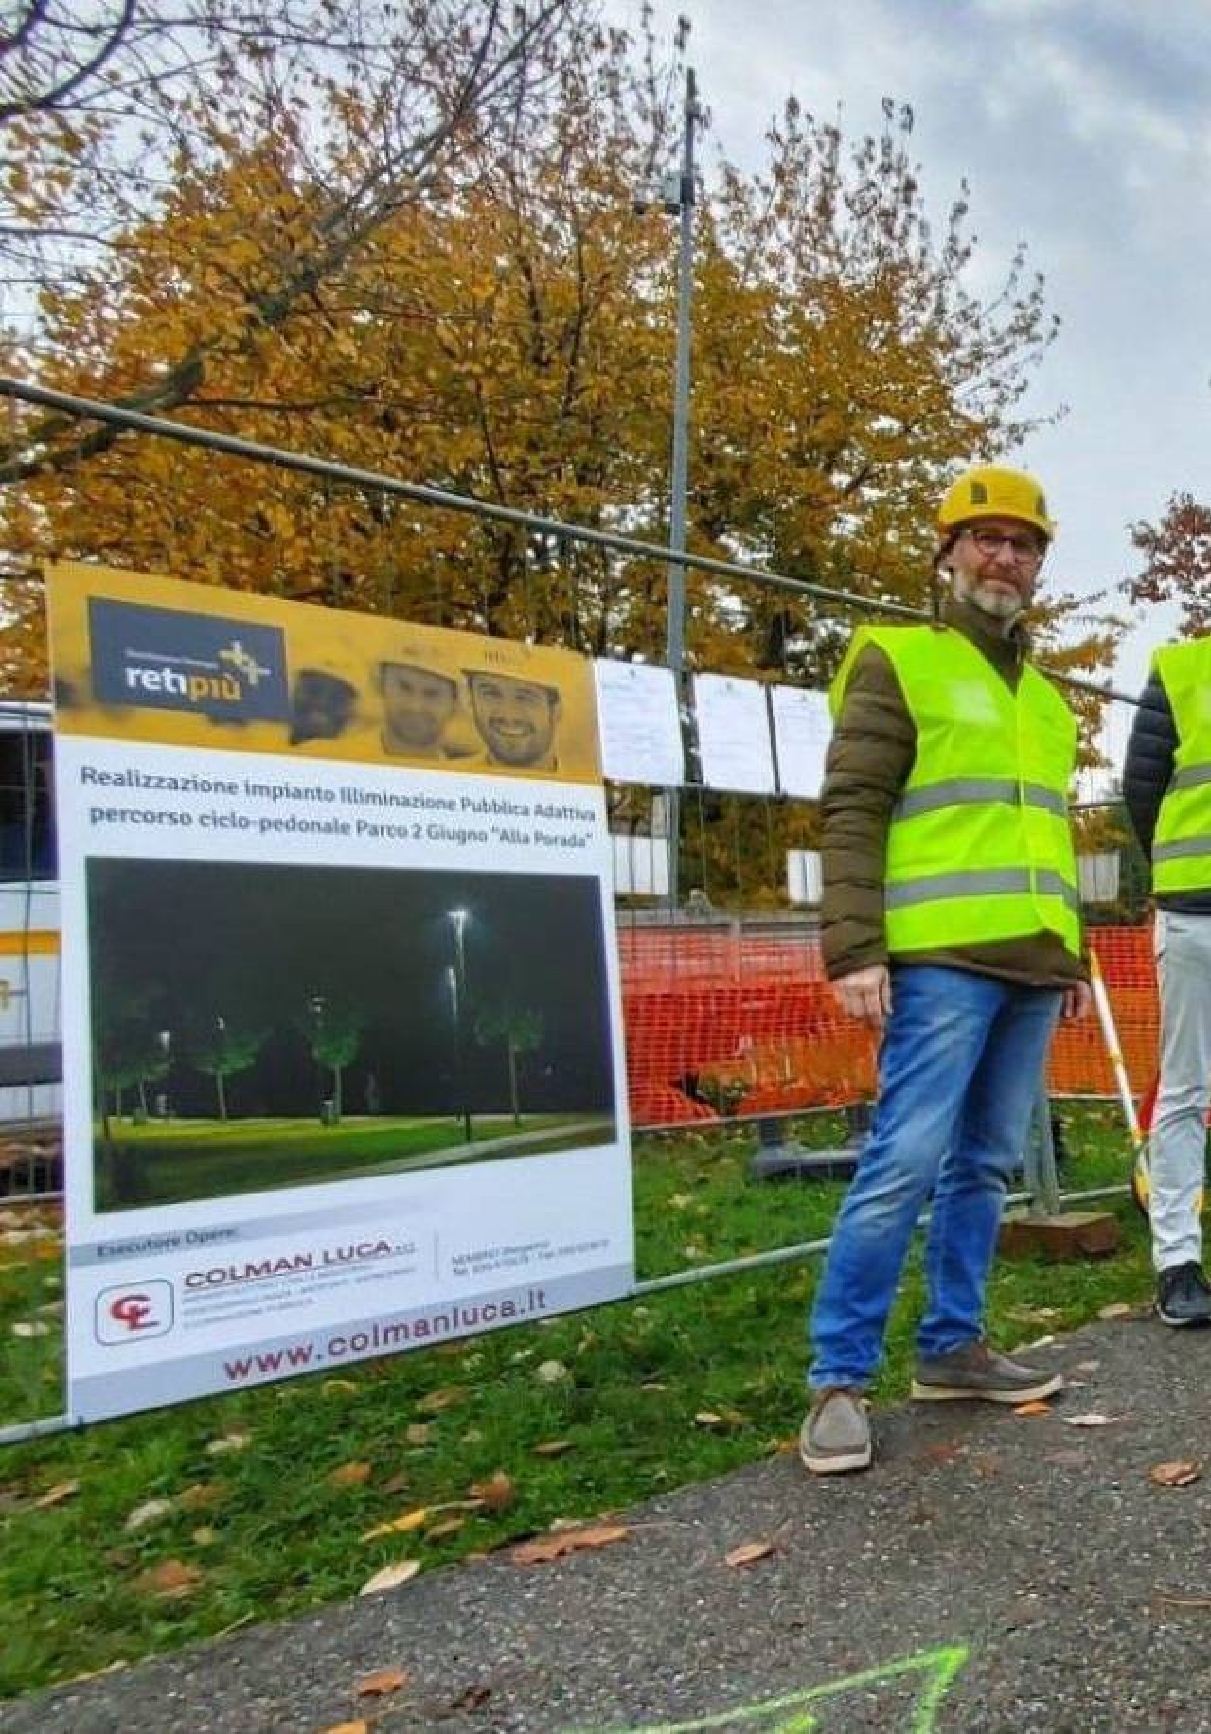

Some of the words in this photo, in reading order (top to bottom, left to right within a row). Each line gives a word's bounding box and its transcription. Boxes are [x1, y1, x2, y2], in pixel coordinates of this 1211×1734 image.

[80, 766, 239, 795] Realizzazione
[244, 777, 336, 802] impianto
[460, 796, 531, 817] Pubblica
[533, 803, 596, 822] Adattiva
[90, 807, 193, 826] percorso
[200, 810, 351, 836] ciclo-pedonale
[355, 819, 409, 839] Parco
[412, 822, 423, 841] 2
[427, 823, 489, 846] Giugno
[185, 1252, 314, 1288] COLMAN
[323, 1240, 391, 1265] LUCA
[223, 1290, 547, 1380] www.colmanluca.it
